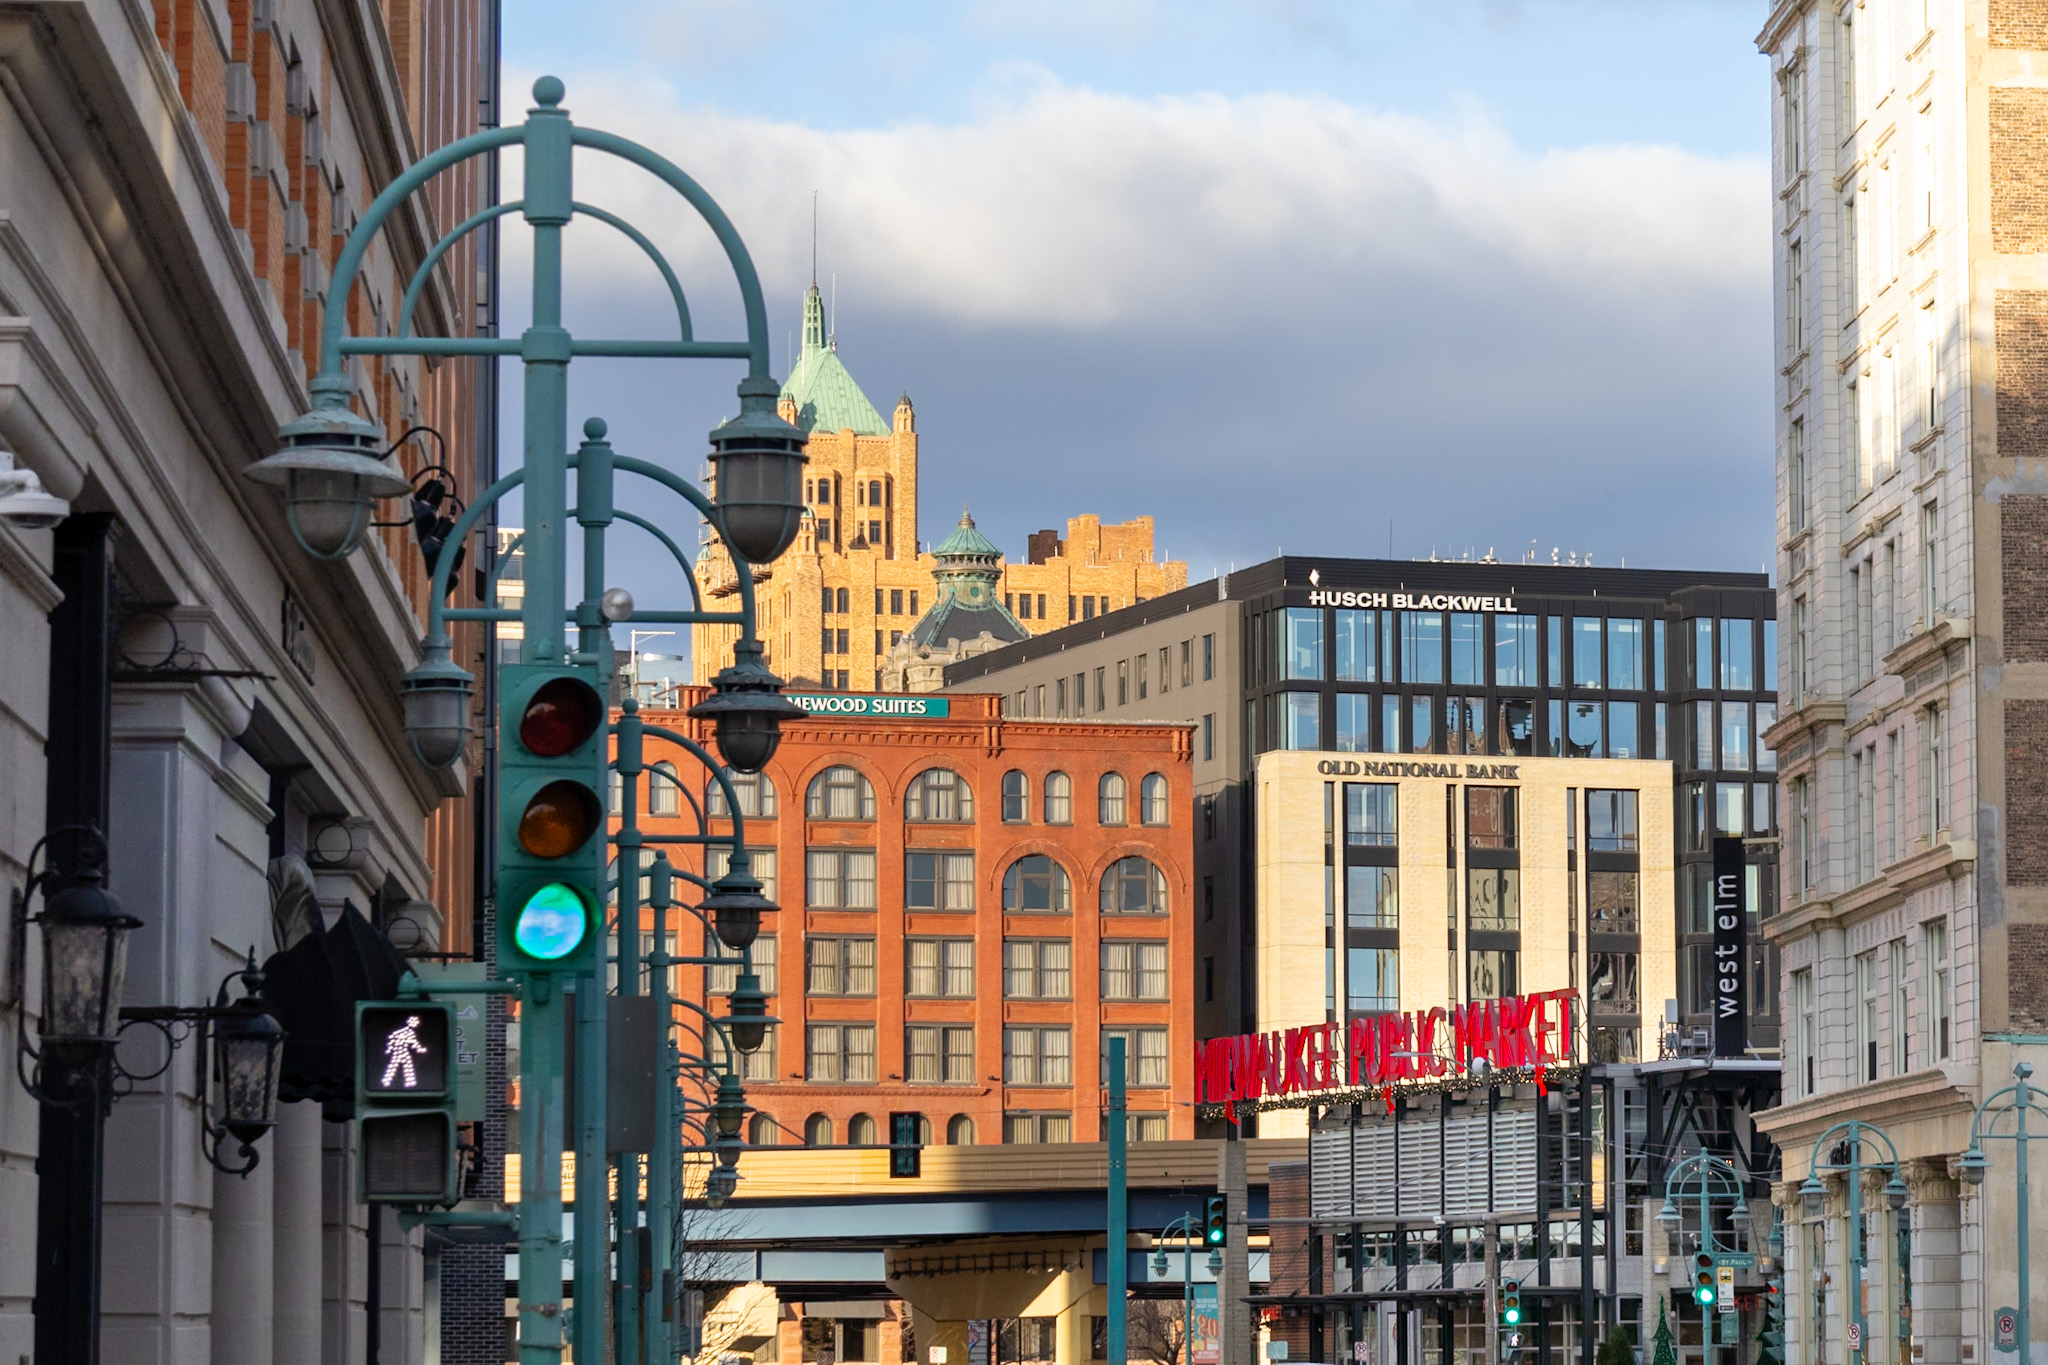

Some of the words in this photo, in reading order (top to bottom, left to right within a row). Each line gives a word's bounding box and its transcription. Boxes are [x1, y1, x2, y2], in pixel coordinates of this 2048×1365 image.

[1309, 591, 1387, 608] HUSCH
[1392, 594, 1518, 612] BLACKWELL
[872, 699, 927, 714] SUITES
[1317, 760, 1361, 775] OLD
[1363, 761, 1463, 778] NATIONAL
[1466, 764, 1521, 780] BANK
[1714, 874, 1739, 931] elm
[1714, 944, 1739, 1019] west
[1194, 1022, 1340, 1103] MILWAUKEE
[1350, 1006, 1447, 1086] PUBLIC
[1455, 987, 1577, 1074] MARKET
